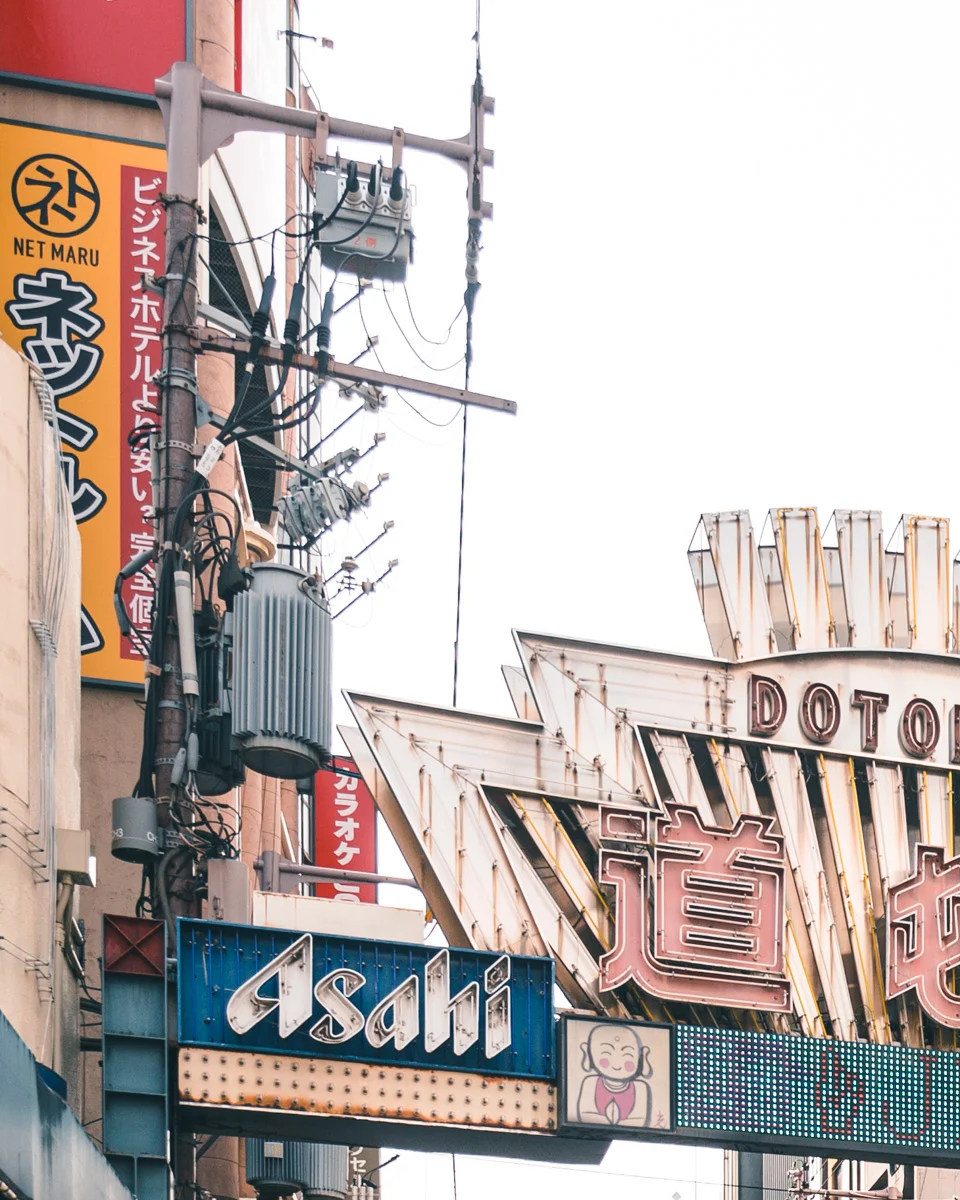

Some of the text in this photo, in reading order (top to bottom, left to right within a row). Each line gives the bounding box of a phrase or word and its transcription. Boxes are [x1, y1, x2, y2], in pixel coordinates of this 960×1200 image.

[13, 237, 99, 267] NET MARU
[333, 767, 361, 865] カラオケ
[227, 933, 511, 1060] Asahi
